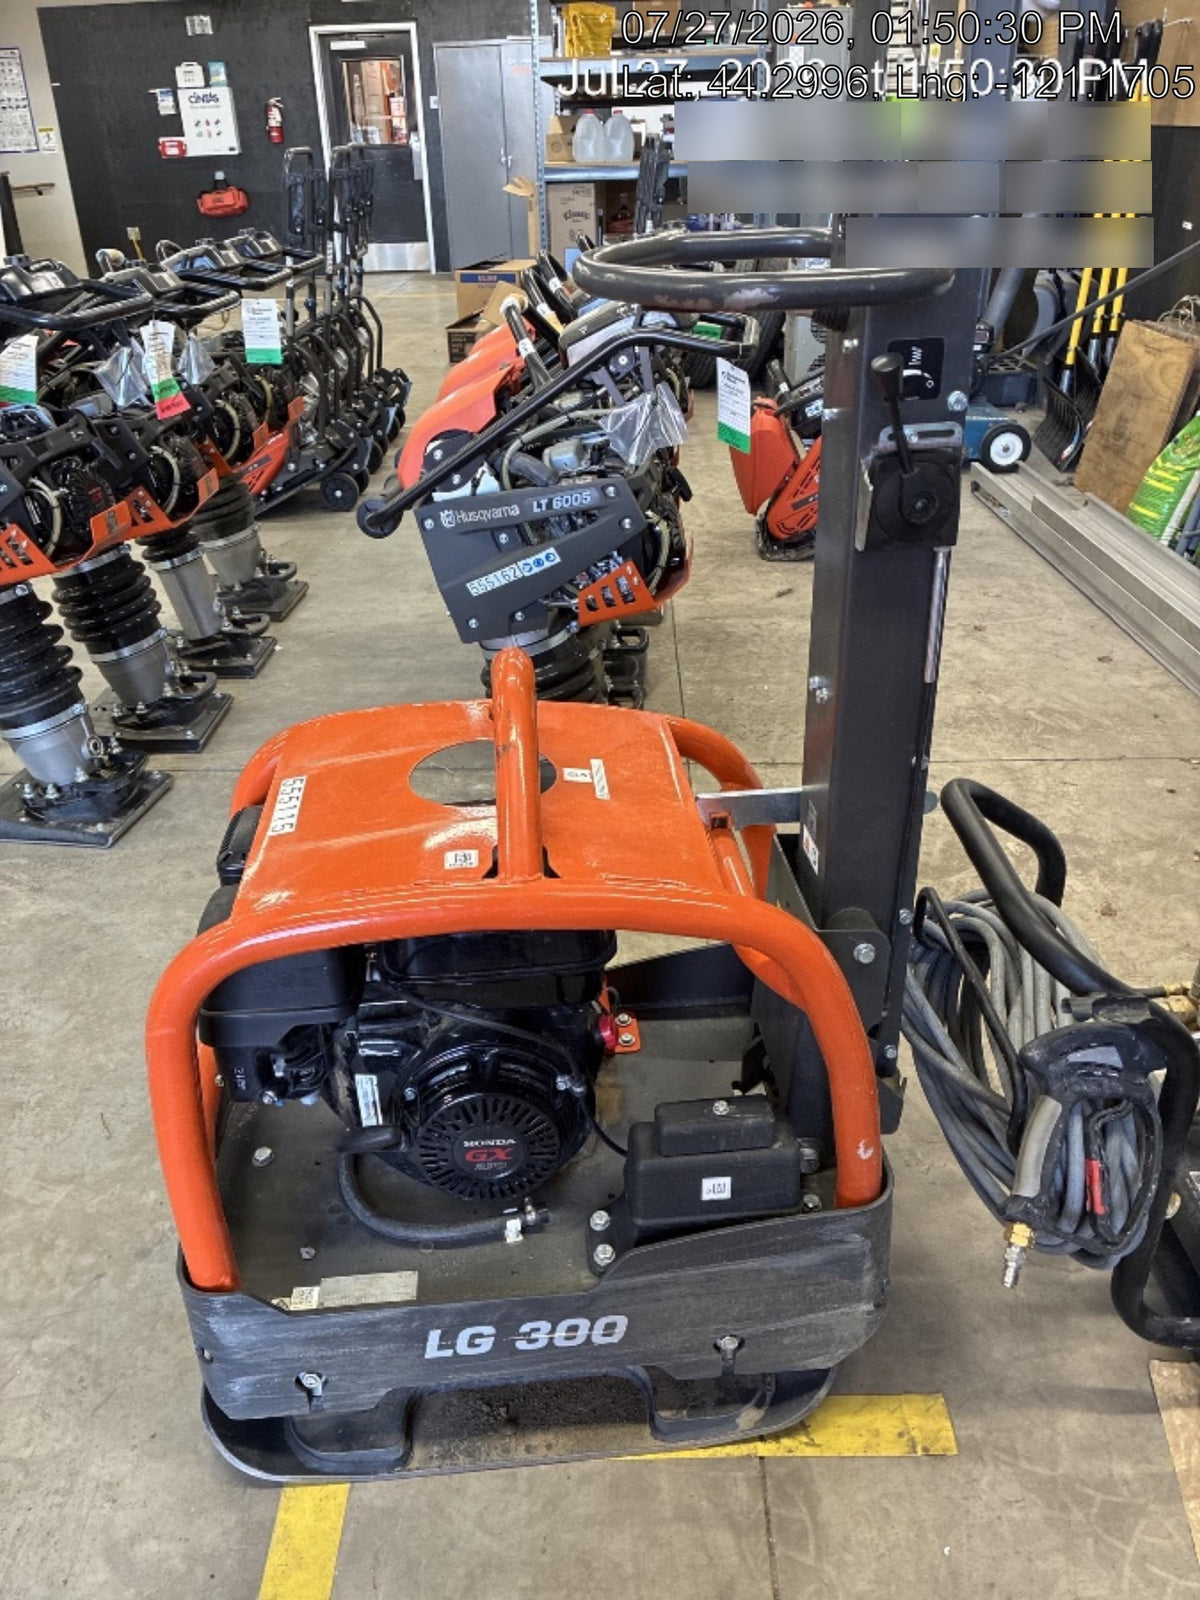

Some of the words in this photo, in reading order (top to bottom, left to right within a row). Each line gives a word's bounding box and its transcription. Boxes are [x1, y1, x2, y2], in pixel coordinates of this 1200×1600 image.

[533, 499, 548, 513] LT
[552, 491, 592, 510] 6005
[454, 504, 520, 524] Husqvarna
[464, 1138, 517, 1148] HONDA
[465, 1147, 513, 1163] GX
[424, 1325, 496, 1359] LG
[515, 1314, 629, 1350] 300
